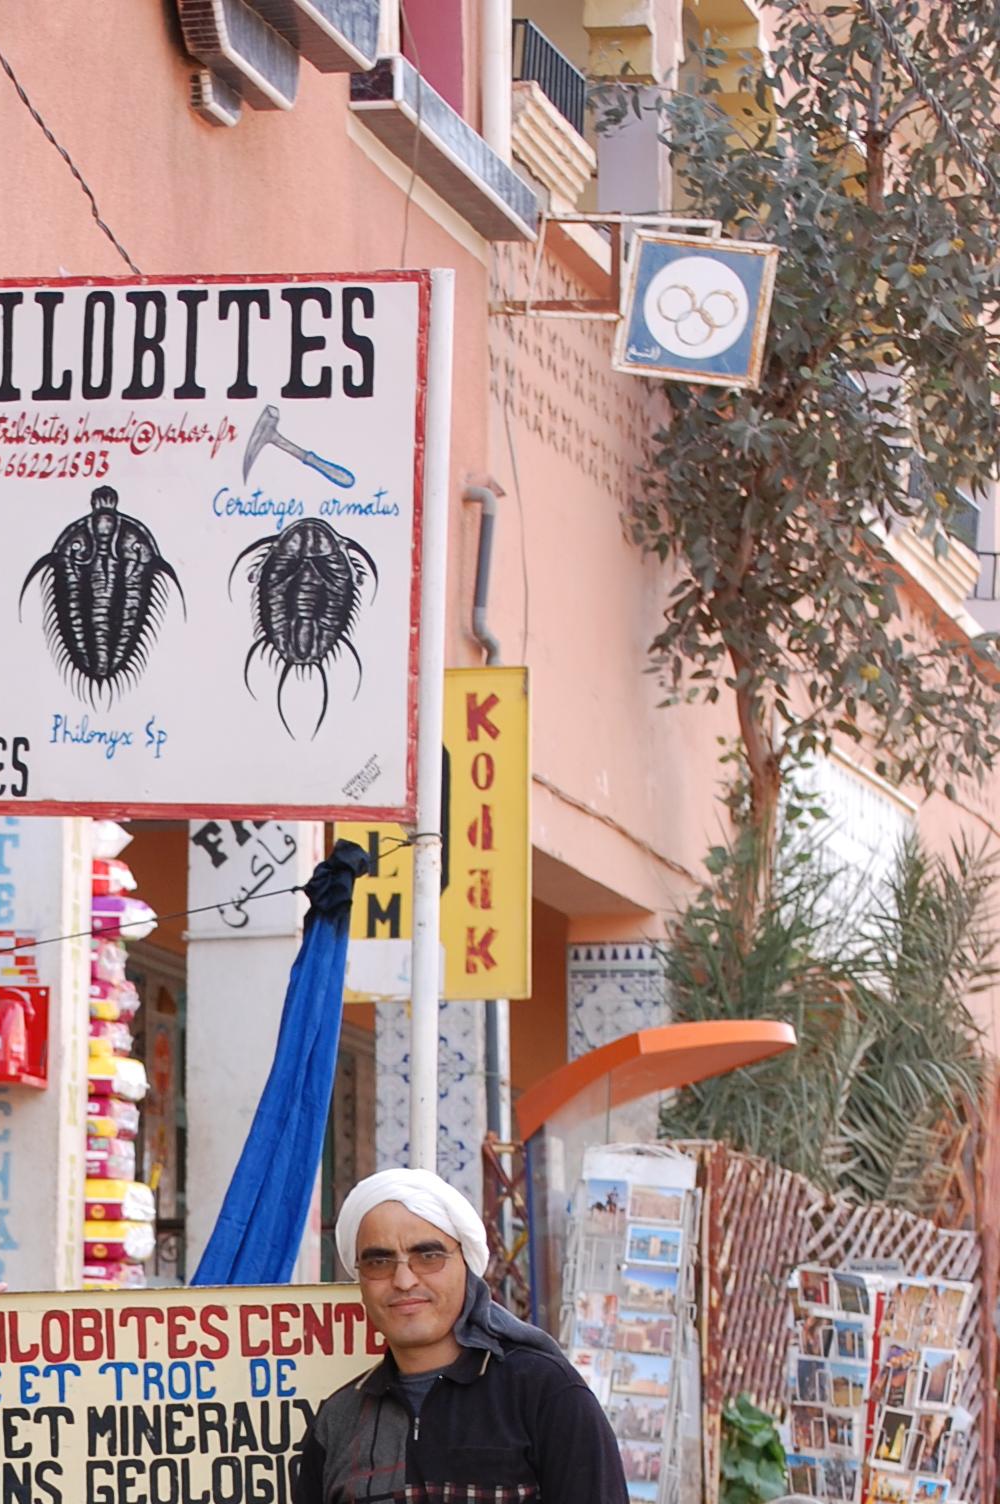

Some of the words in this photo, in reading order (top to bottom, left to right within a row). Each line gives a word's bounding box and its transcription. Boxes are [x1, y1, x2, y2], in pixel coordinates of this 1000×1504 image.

[239, 1303, 388, 1358] CENTE
[19, 1362, 81, 1404] ET
[100, 1361, 216, 1401] TROC
[250, 1358, 297, 1398] DE
[2, 1406, 75, 1459] ET
[87, 1399, 328, 1458] MINERAUX
